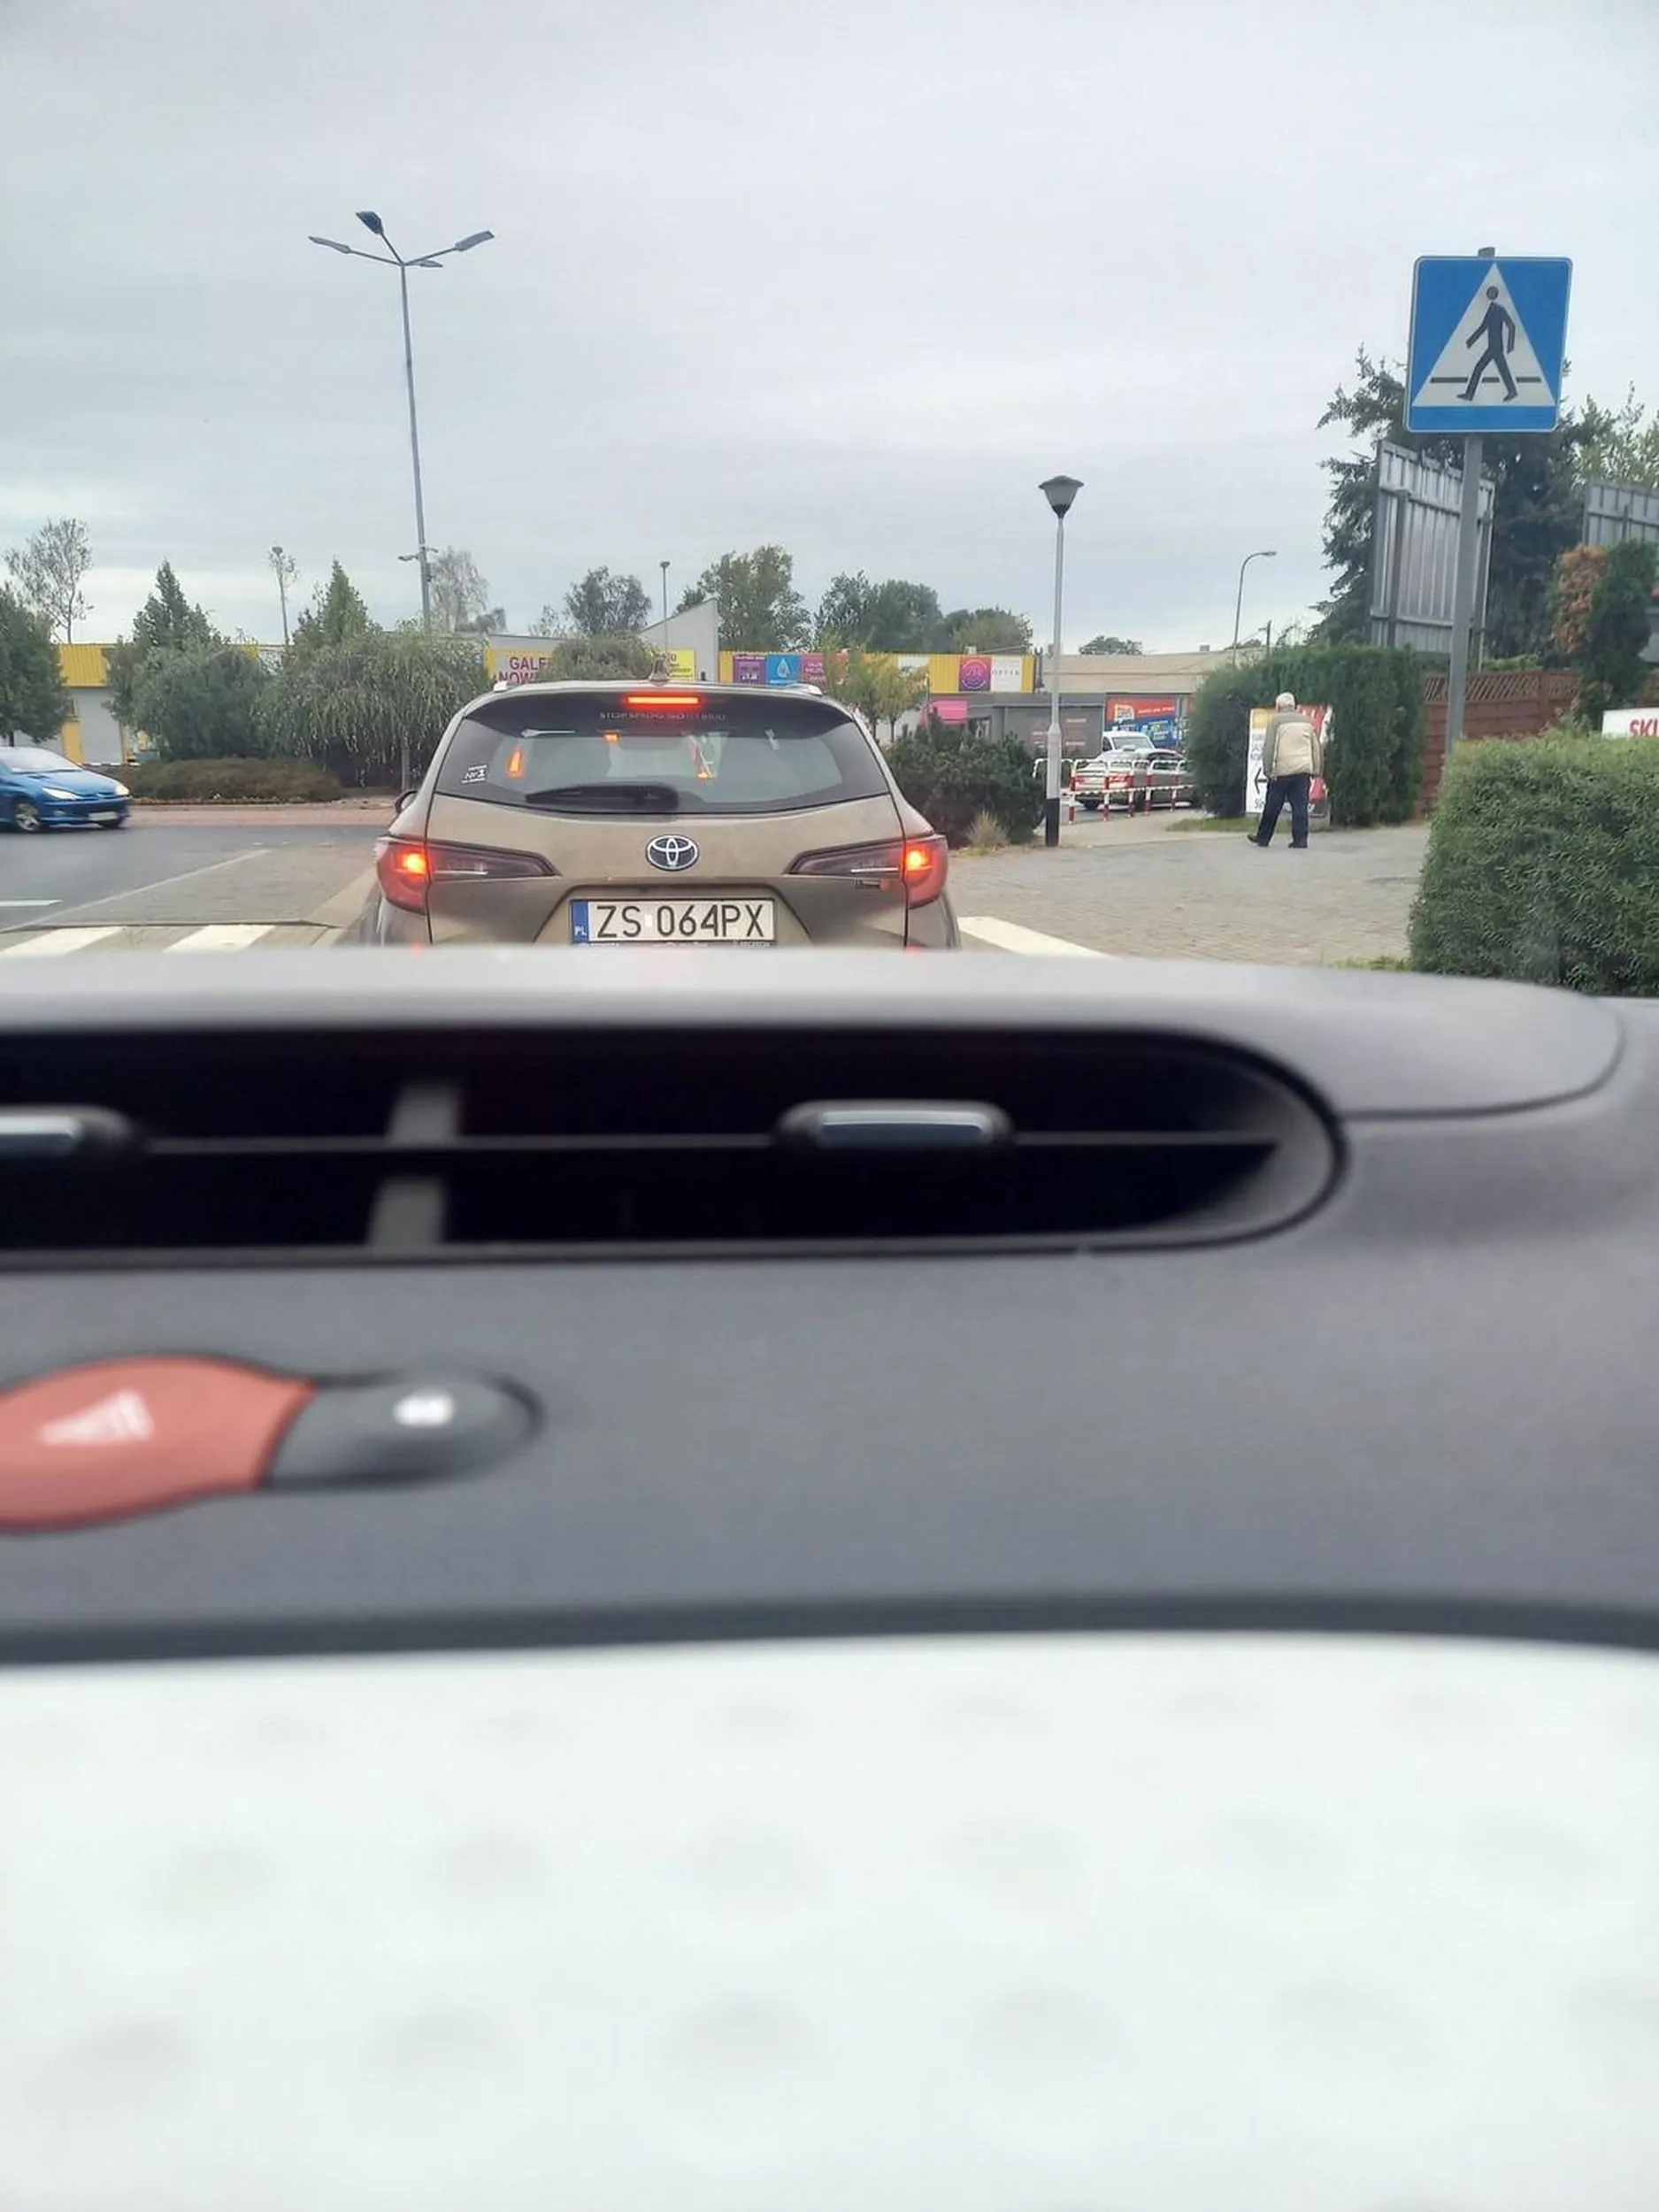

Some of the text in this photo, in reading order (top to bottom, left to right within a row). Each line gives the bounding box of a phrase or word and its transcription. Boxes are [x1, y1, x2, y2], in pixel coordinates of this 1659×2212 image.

[509, 657, 549, 670] GALE
[596, 903, 764, 938] ZS 064PX
[574, 926, 588, 937] PL
